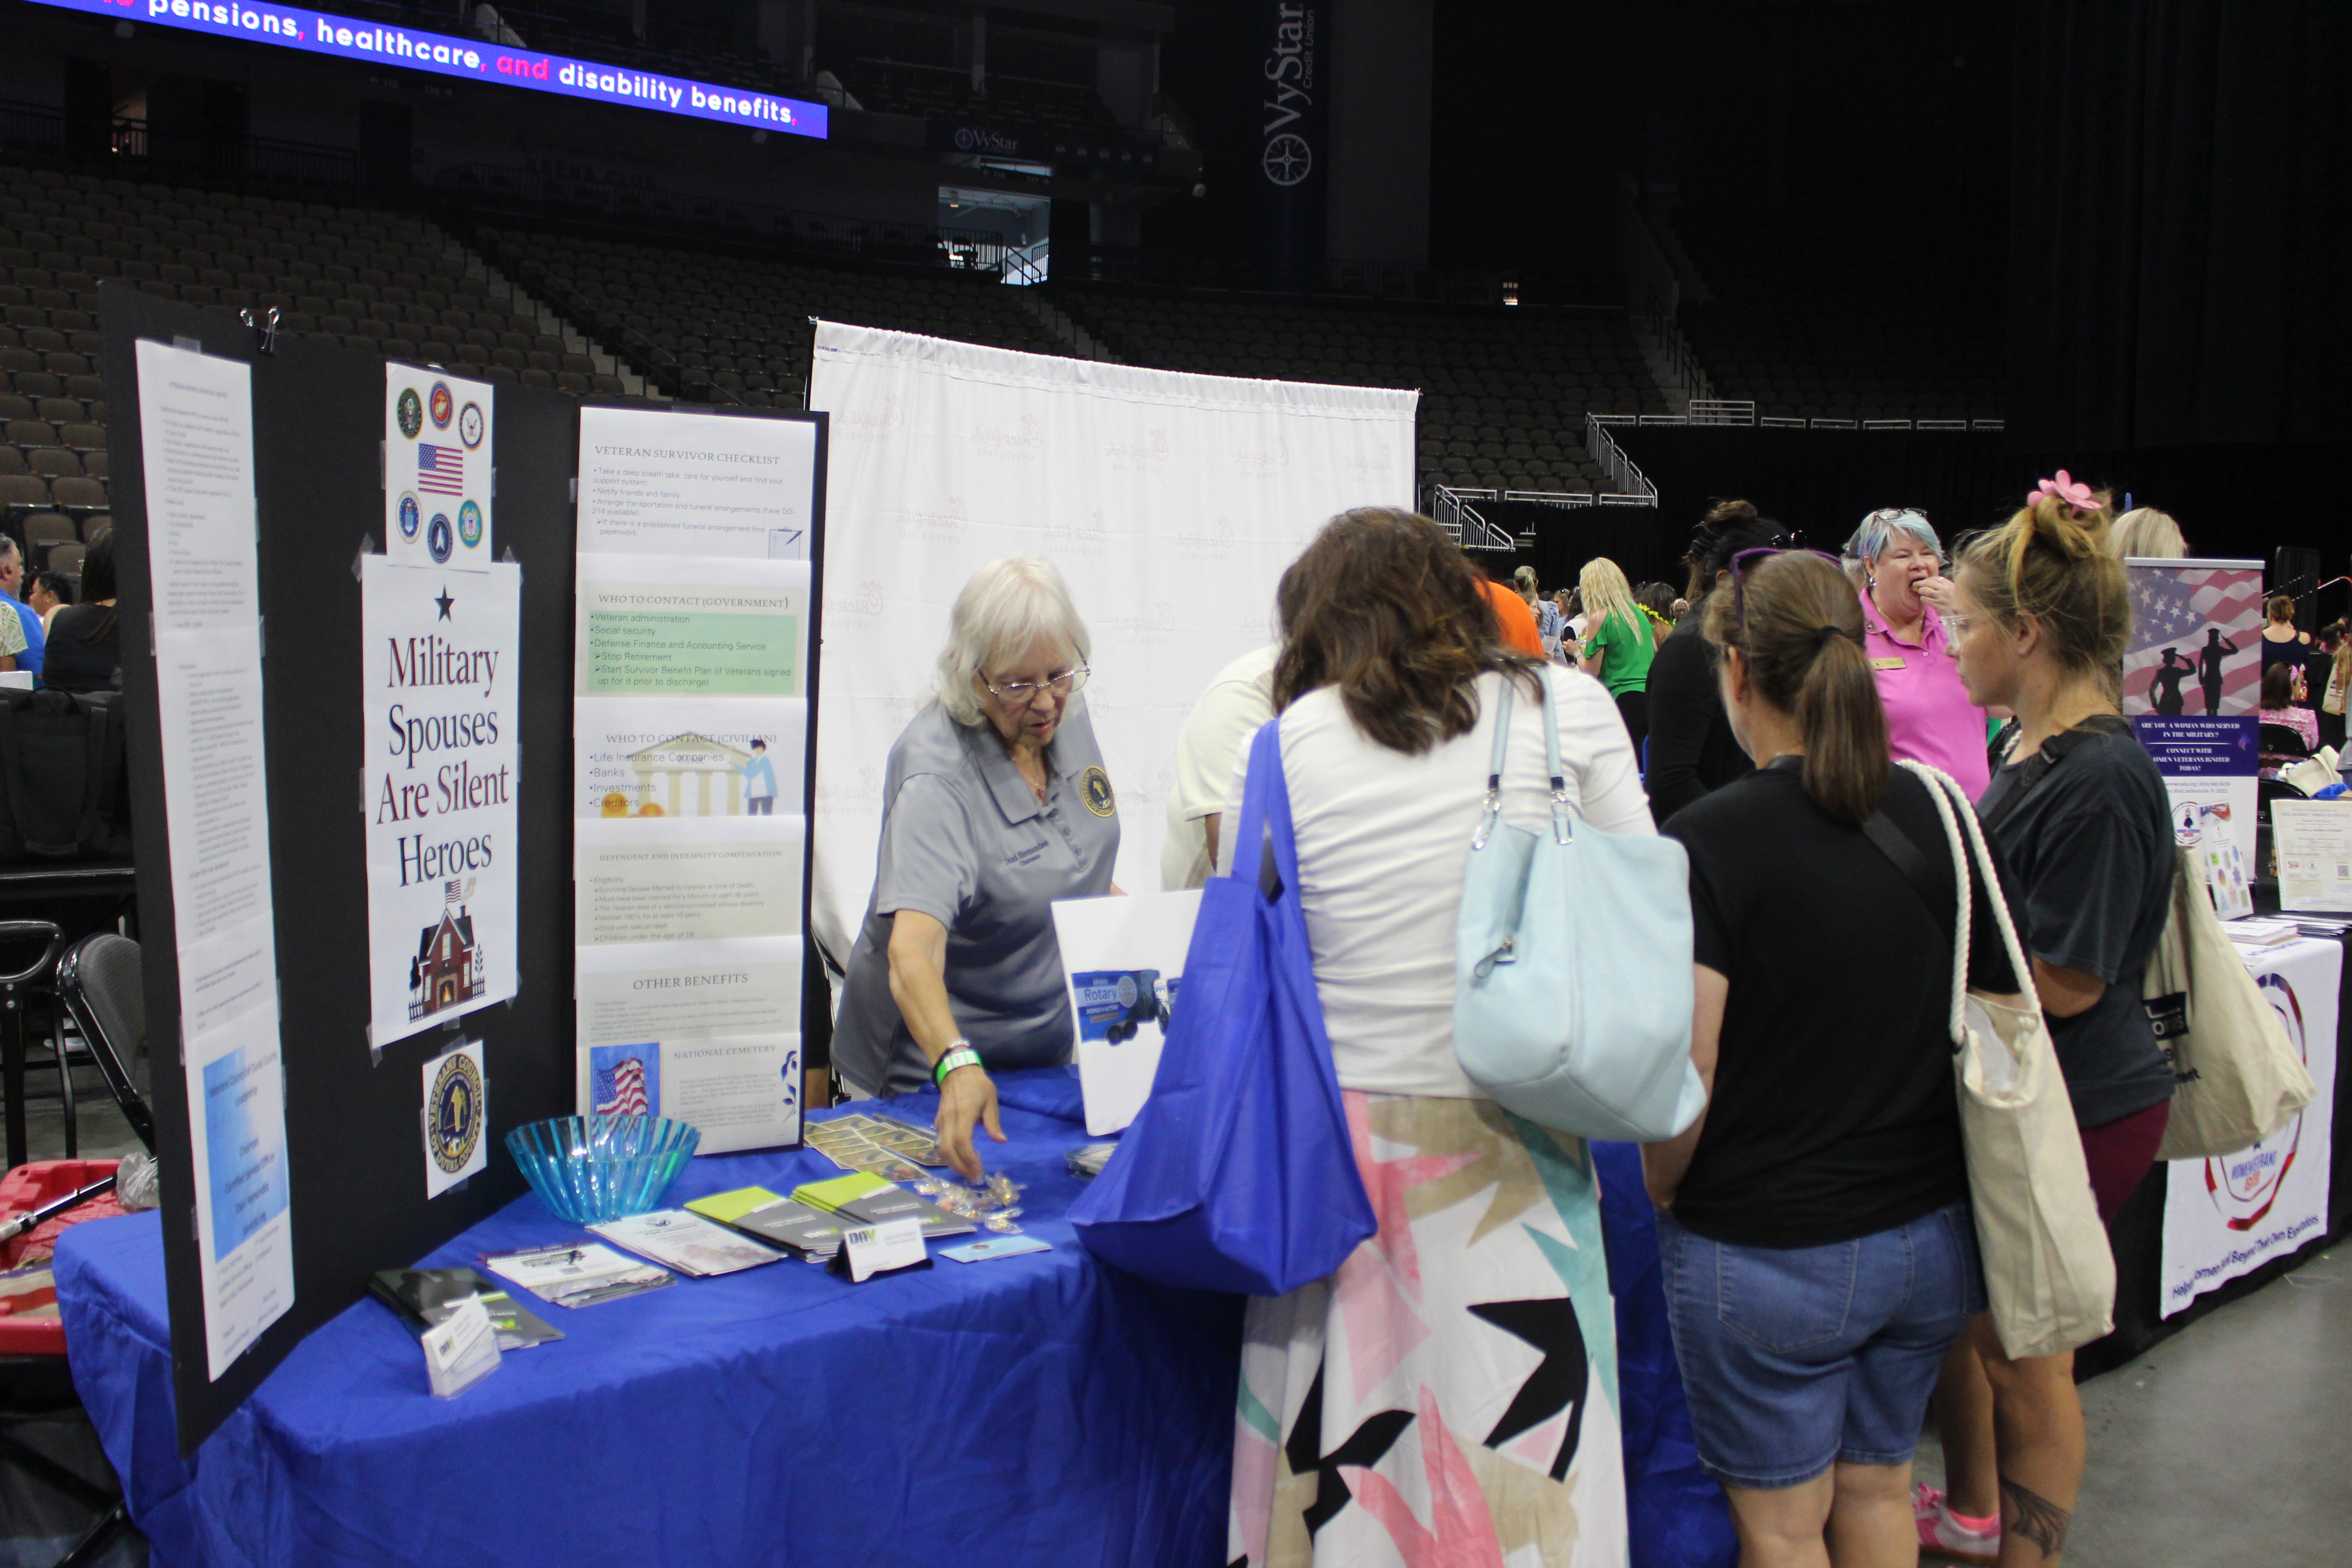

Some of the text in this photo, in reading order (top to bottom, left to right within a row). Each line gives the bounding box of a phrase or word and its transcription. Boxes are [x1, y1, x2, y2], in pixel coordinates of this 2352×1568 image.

[149, 0, 304, 41] pensions,
[318, 18, 487, 73] healthcare,
[496, 59, 549, 81] and
[559, 64, 683, 108] disability
[1303, 10, 1314, 89] Credit Union
[1264, 2, 1312, 137] VyStar
[974, 130, 1019, 151] VyStar
[594, 446, 779, 464] VETERAN SURVIVOR CHECKLIST
[622, 469, 640, 477] deep
[597, 487, 618, 496] Notify
[660, 491, 682, 499] family.
[596, 499, 624, 507] Arrange
[598, 594, 788, 609] WHO TO CONTACT (GOVERNMENT)
[594, 612, 690, 622] Veteran administration
[594, 626, 656, 637] Social security
[593, 638, 631, 647] Defense
[633, 639, 666, 648] Finance
[686, 641, 733, 651] Accounting
[735, 642, 766, 650] Service
[601, 652, 671, 662] Stop Retirement
[387, 635, 499, 699] Military
[601, 665, 622, 673] Start
[624, 665, 659, 674] Survivor
[661, 666, 691, 674] Benefit
[694, 666, 711, 675] Plan
[724, 667, 761, 676] Veterans
[763, 669, 790, 677] signed
[597, 678, 609, 686] up
[611, 676, 623, 685] for
[633, 678, 652, 686] prior
[666, 678, 709, 687] discharge)
[388, 704, 499, 770] Spouses
[606, 735, 777, 744] WHO TO CONTACT (CIVILIAN)
[593, 753, 724, 763] Life Insurance Companies
[594, 768, 625, 778] Banks
[376, 760, 510, 825] Are Silent
[593, 783, 656, 793] Investments
[593, 799, 639, 808] Creditors
[1017, 840, 1049, 860] Hernandez
[397, 833, 493, 887] Heroes
[633, 974, 747, 990] OTHER BENEFITS
[1084, 988, 1117, 1002] Rotary
[673, 1045, 775, 1059] NATIONAL CEMETERY
[429, 1055, 457, 1125] VETERANS
[458, 1056, 481, 1108] COUNCIL
[436, 1153, 459, 1172] DUVAL
[848, 1229, 876, 1246] DAV
